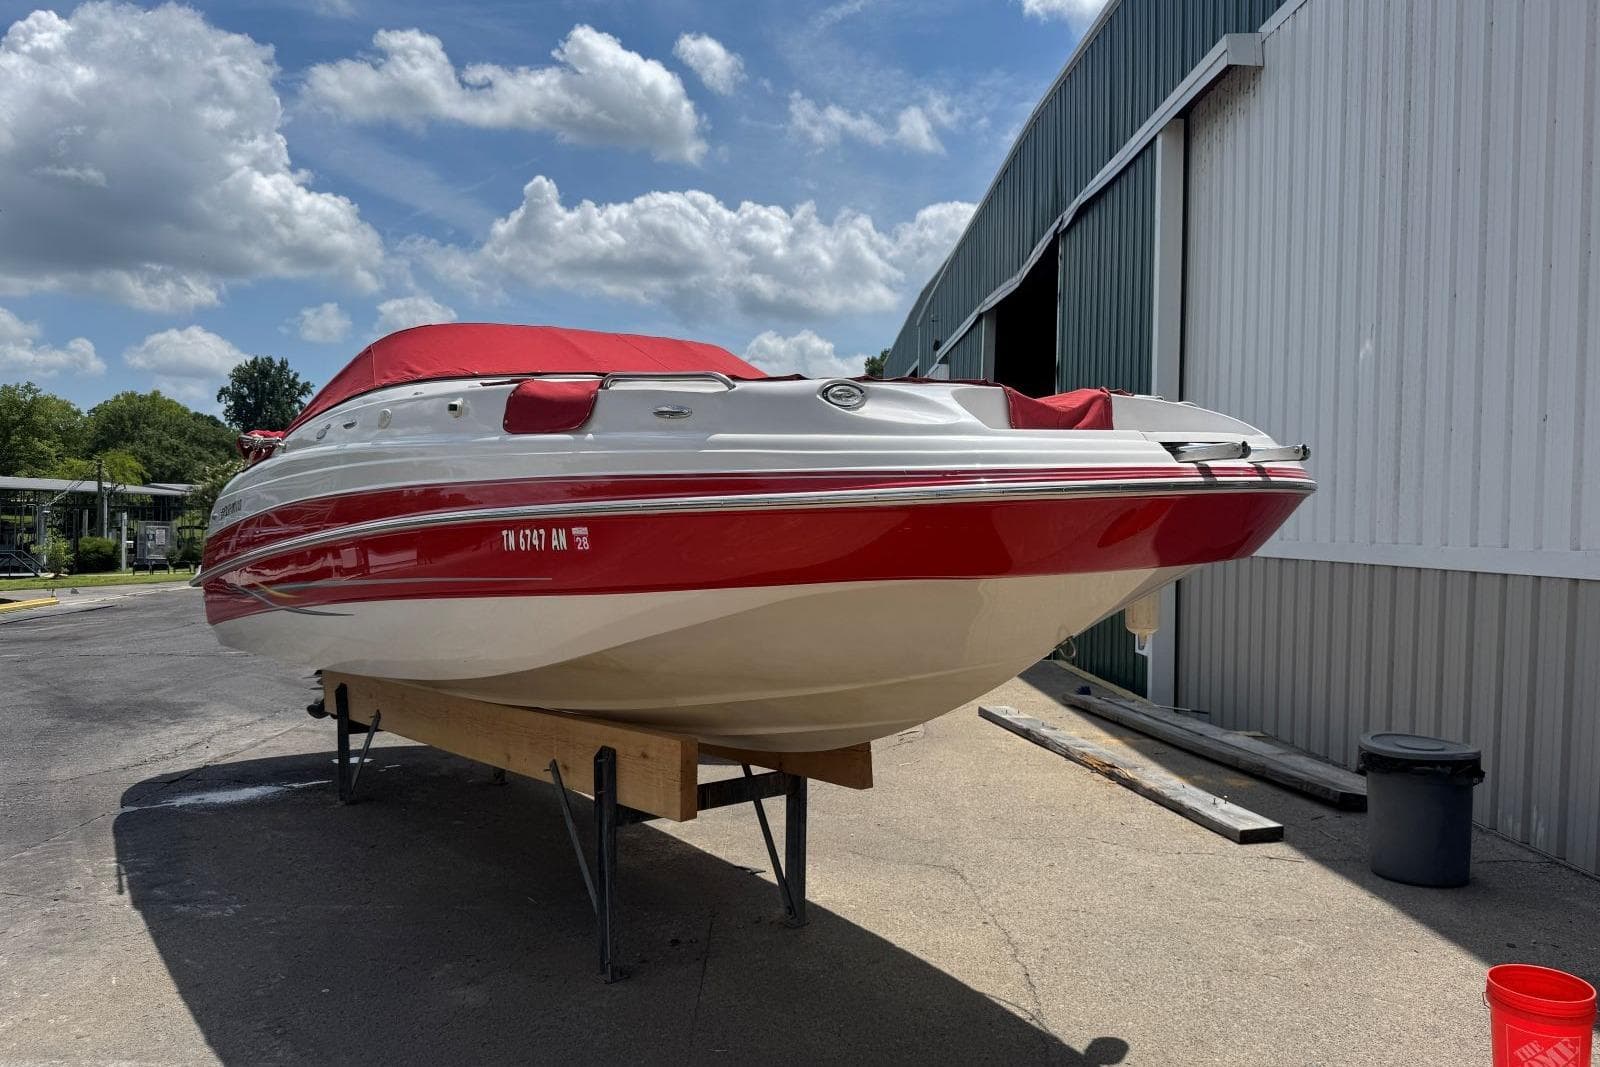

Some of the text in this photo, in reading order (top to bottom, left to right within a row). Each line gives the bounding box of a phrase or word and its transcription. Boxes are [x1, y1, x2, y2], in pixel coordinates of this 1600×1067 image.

[502, 527, 567, 551] TN 6747 AN
[575, 536, 590, 550] 28
[1513, 1040, 1545, 1062] THE
